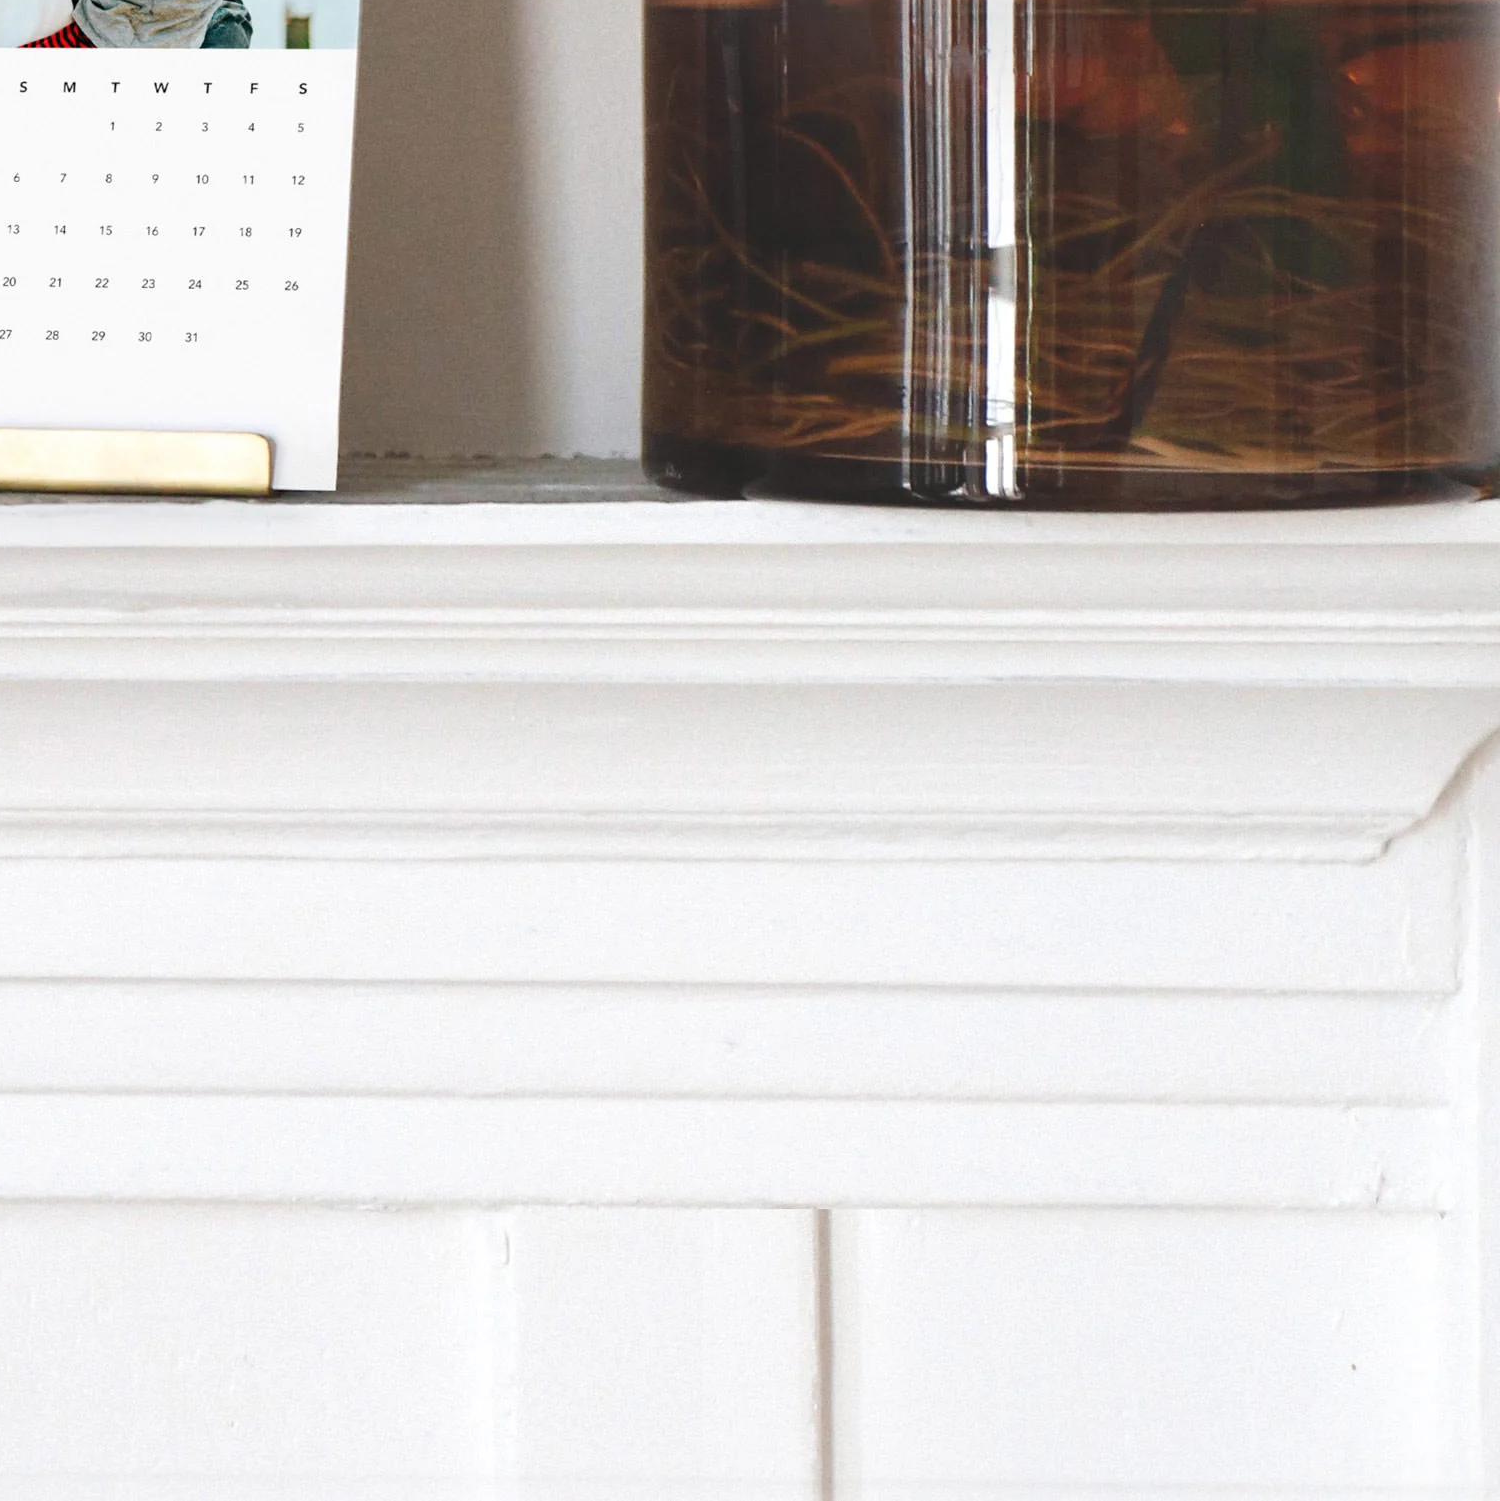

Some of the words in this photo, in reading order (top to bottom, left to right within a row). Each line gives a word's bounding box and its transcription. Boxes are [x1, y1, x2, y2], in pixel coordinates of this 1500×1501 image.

[20, 81, 27, 93] S
[63, 81, 76, 93] M
[111, 82, 121, 93] T
[154, 82, 169, 94] W
[204, 82, 212, 94] T
[250, 83, 258, 94] F
[299, 83, 307, 94] S
[110, 121, 115, 131] 1
[156, 122, 162, 131] 2
[202, 122, 208, 132] 3
[248, 122, 255, 132] 4
[298, 122, 304, 132] 5
[13, 173, 20, 182] 6
[60, 173, 67, 183] 7
[105, 173, 112, 183] 8
[152, 174, 159, 184] 9
[196, 174, 209, 184] 10
[243, 175, 254, 184] 11
[292, 175, 305, 185] 12
[8, 224, 20, 234] 13
[54, 225, 66, 234] 14
[100, 225, 112, 235] 15
[147, 226, 158, 236] 16
[193, 227, 205, 236] 17
[240, 227, 252, 237] 18
[289, 228, 302, 237] 19
[3, 277, 16, 287] 20
[49, 277, 61, 287] 21
[95, 278, 109, 288] 22
[141, 279, 155, 288] 23
[189, 279, 202, 289] 24
[236, 280, 249, 290] 25
[285, 280, 299, 291] 26
[0, 329, 12, 339] 27
[46, 330, 59, 340] 28
[92, 331, 105, 341] 29
[138, 332, 152, 342] 30
[185, 332, 197, 343] 31
